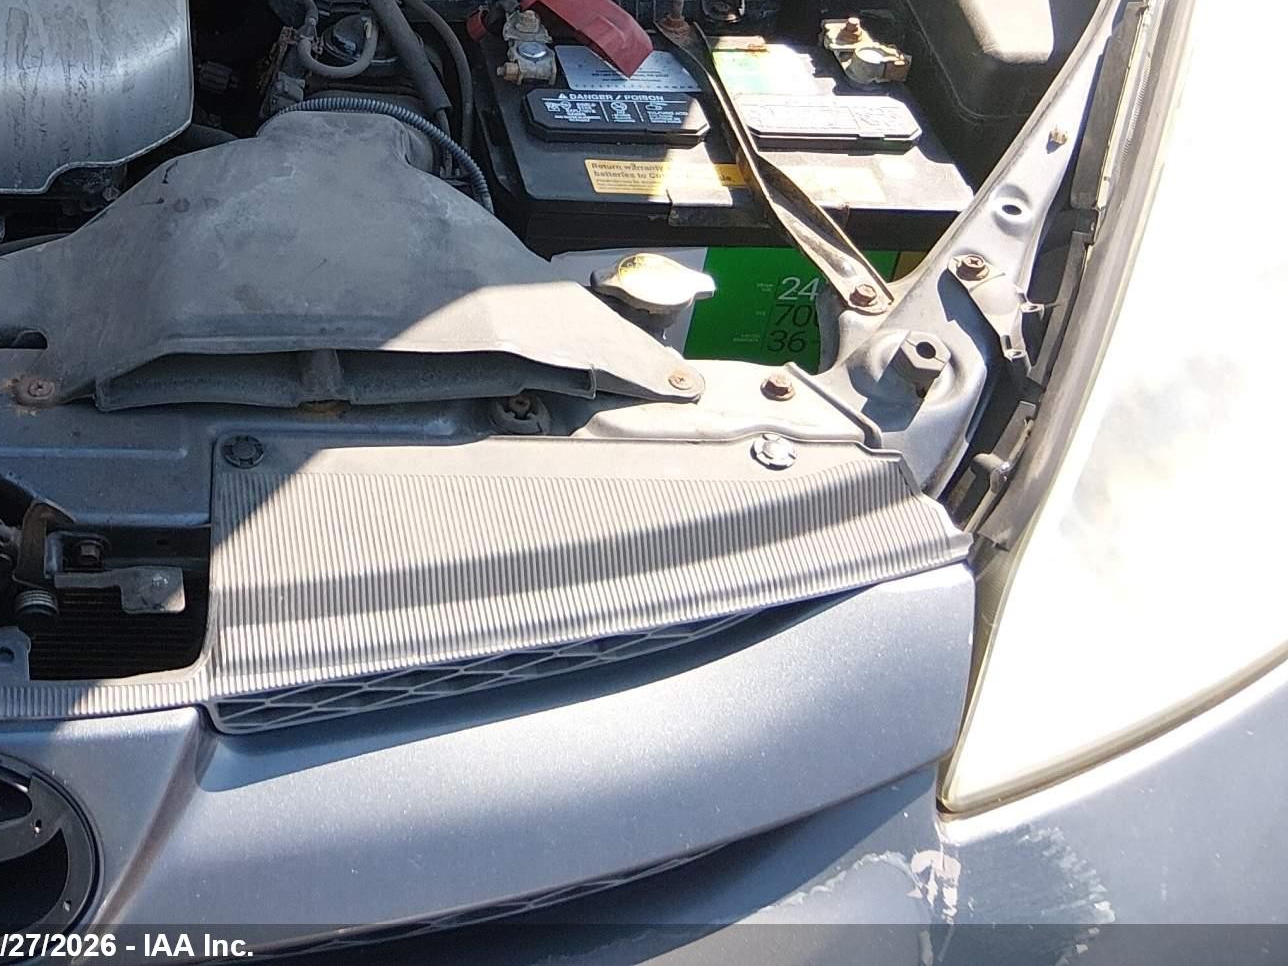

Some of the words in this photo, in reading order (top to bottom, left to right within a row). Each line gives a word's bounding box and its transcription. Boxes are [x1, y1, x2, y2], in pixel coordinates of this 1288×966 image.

[570, 93, 613, 101] DANGER
[624, 94, 664, 102] POISON
[591, 162, 621, 170] Return
[594, 170, 635, 179] batteries
[777, 276, 820, 301] 24
